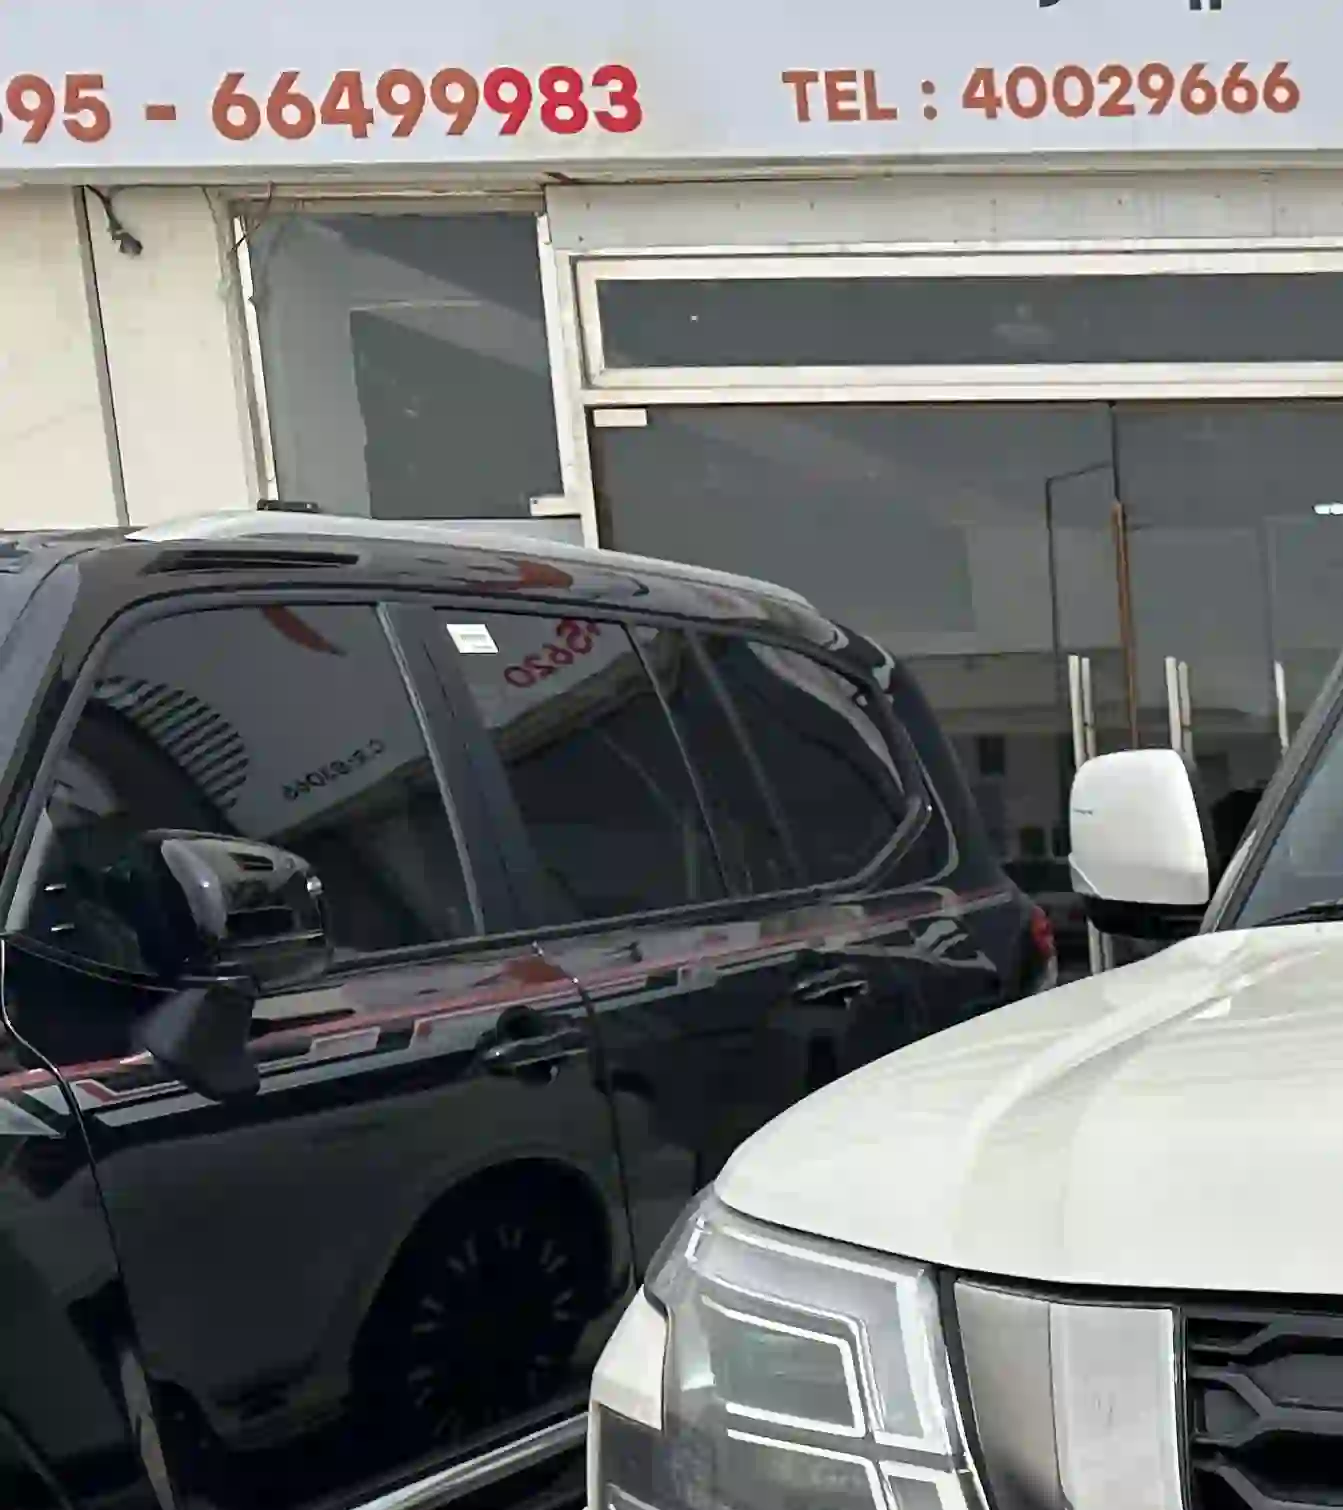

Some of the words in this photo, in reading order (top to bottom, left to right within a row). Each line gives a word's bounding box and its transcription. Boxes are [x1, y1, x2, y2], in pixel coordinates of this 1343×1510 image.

[0, 73, 112, 144] 95
[211, 64, 643, 141] 66499983
[781, 69, 898, 123] TEL
[962, 61, 1300, 120] 40029666
